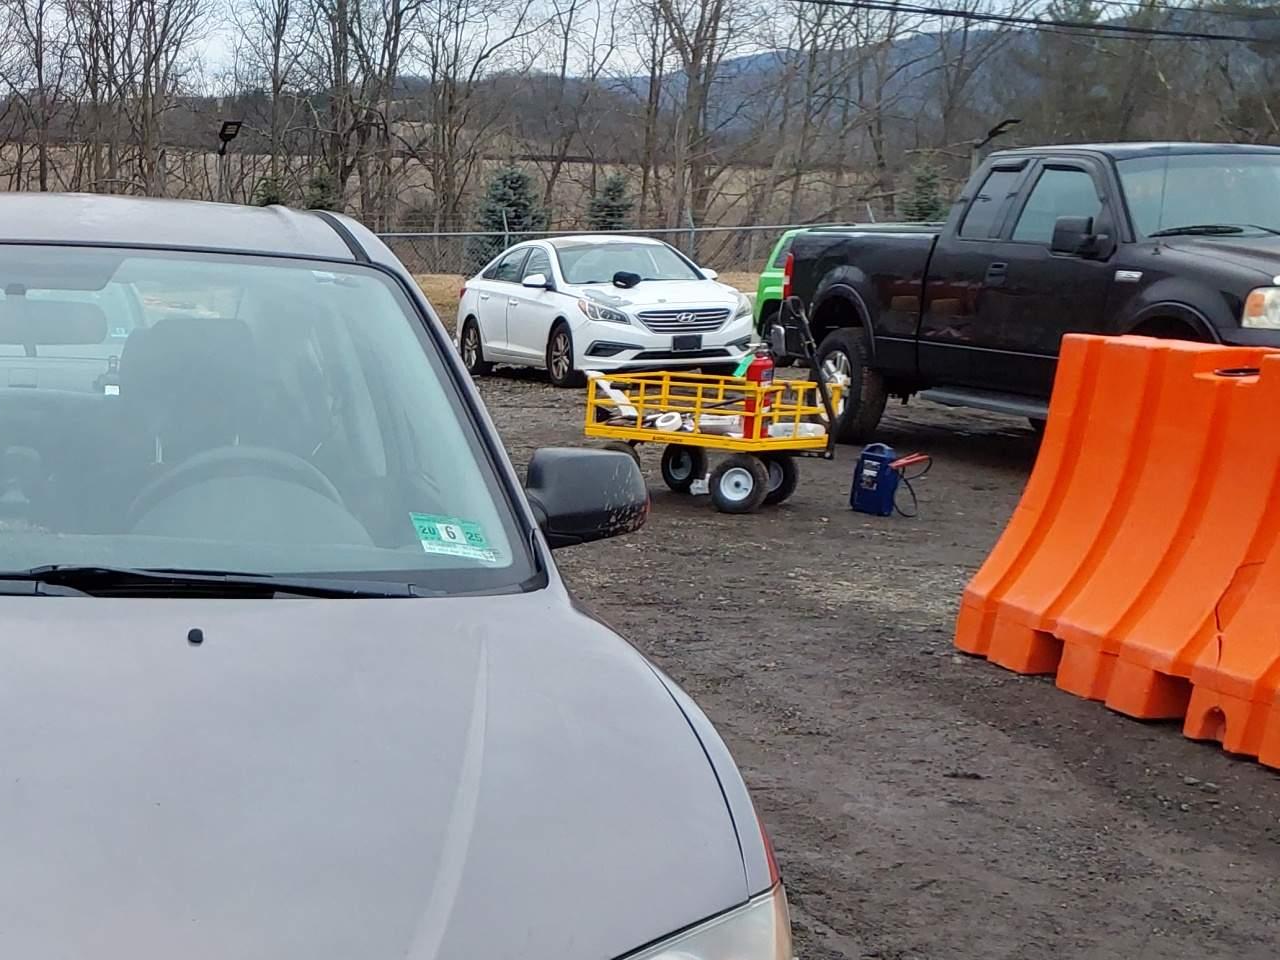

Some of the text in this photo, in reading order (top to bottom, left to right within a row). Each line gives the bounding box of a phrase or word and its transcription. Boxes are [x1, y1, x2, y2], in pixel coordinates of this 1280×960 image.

[420, 525, 482, 542] 20 6 25
